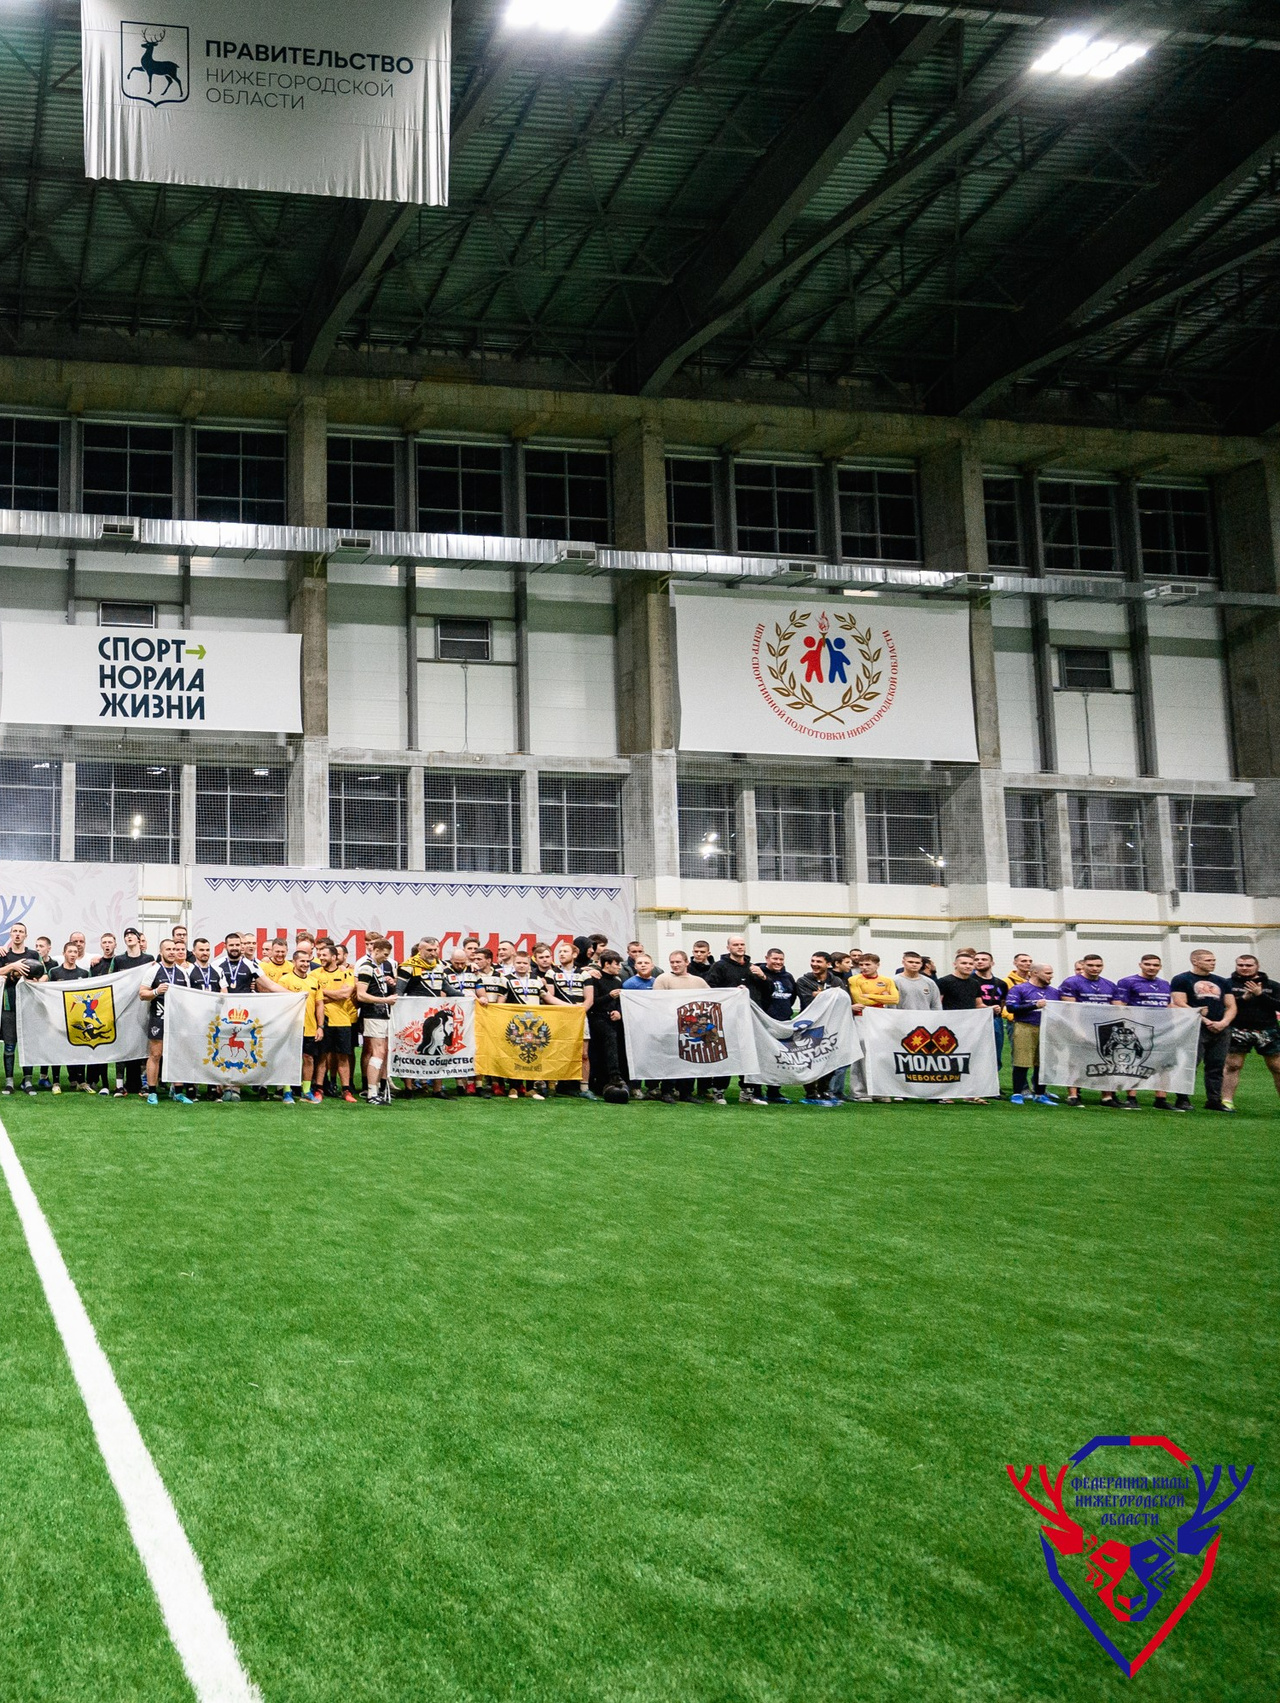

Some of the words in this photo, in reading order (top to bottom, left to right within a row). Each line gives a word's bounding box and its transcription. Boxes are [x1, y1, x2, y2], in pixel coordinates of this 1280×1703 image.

[205, 39, 414, 75] ПРАВИТЕЛЬСТВО
[206, 68, 394, 98] НИЖЕГОРОДСКОЙ
[205, 87, 304, 110] ОБЛАСТИ
[98, 636, 186, 663] СПОРТ
[751, 623, 766, 655] ЦЕНТР
[882, 629, 899, 674] ОБЛАСТИ
[99, 664, 205, 692] НОРМА
[751, 656, 787, 719] СПОРТИВНОЙ
[98, 692, 205, 720] ЖИЗНИ
[847, 675, 899, 738] НИЖЕГОРОДСКОЙ
[784, 716, 846, 741] ПОДГОТОВКИ
[393, 1055, 427, 1067] Русское
[896, 1054, 970, 1072] МОЛОТ
[1087, 1064, 1155, 1079] ДРУЖИНА
